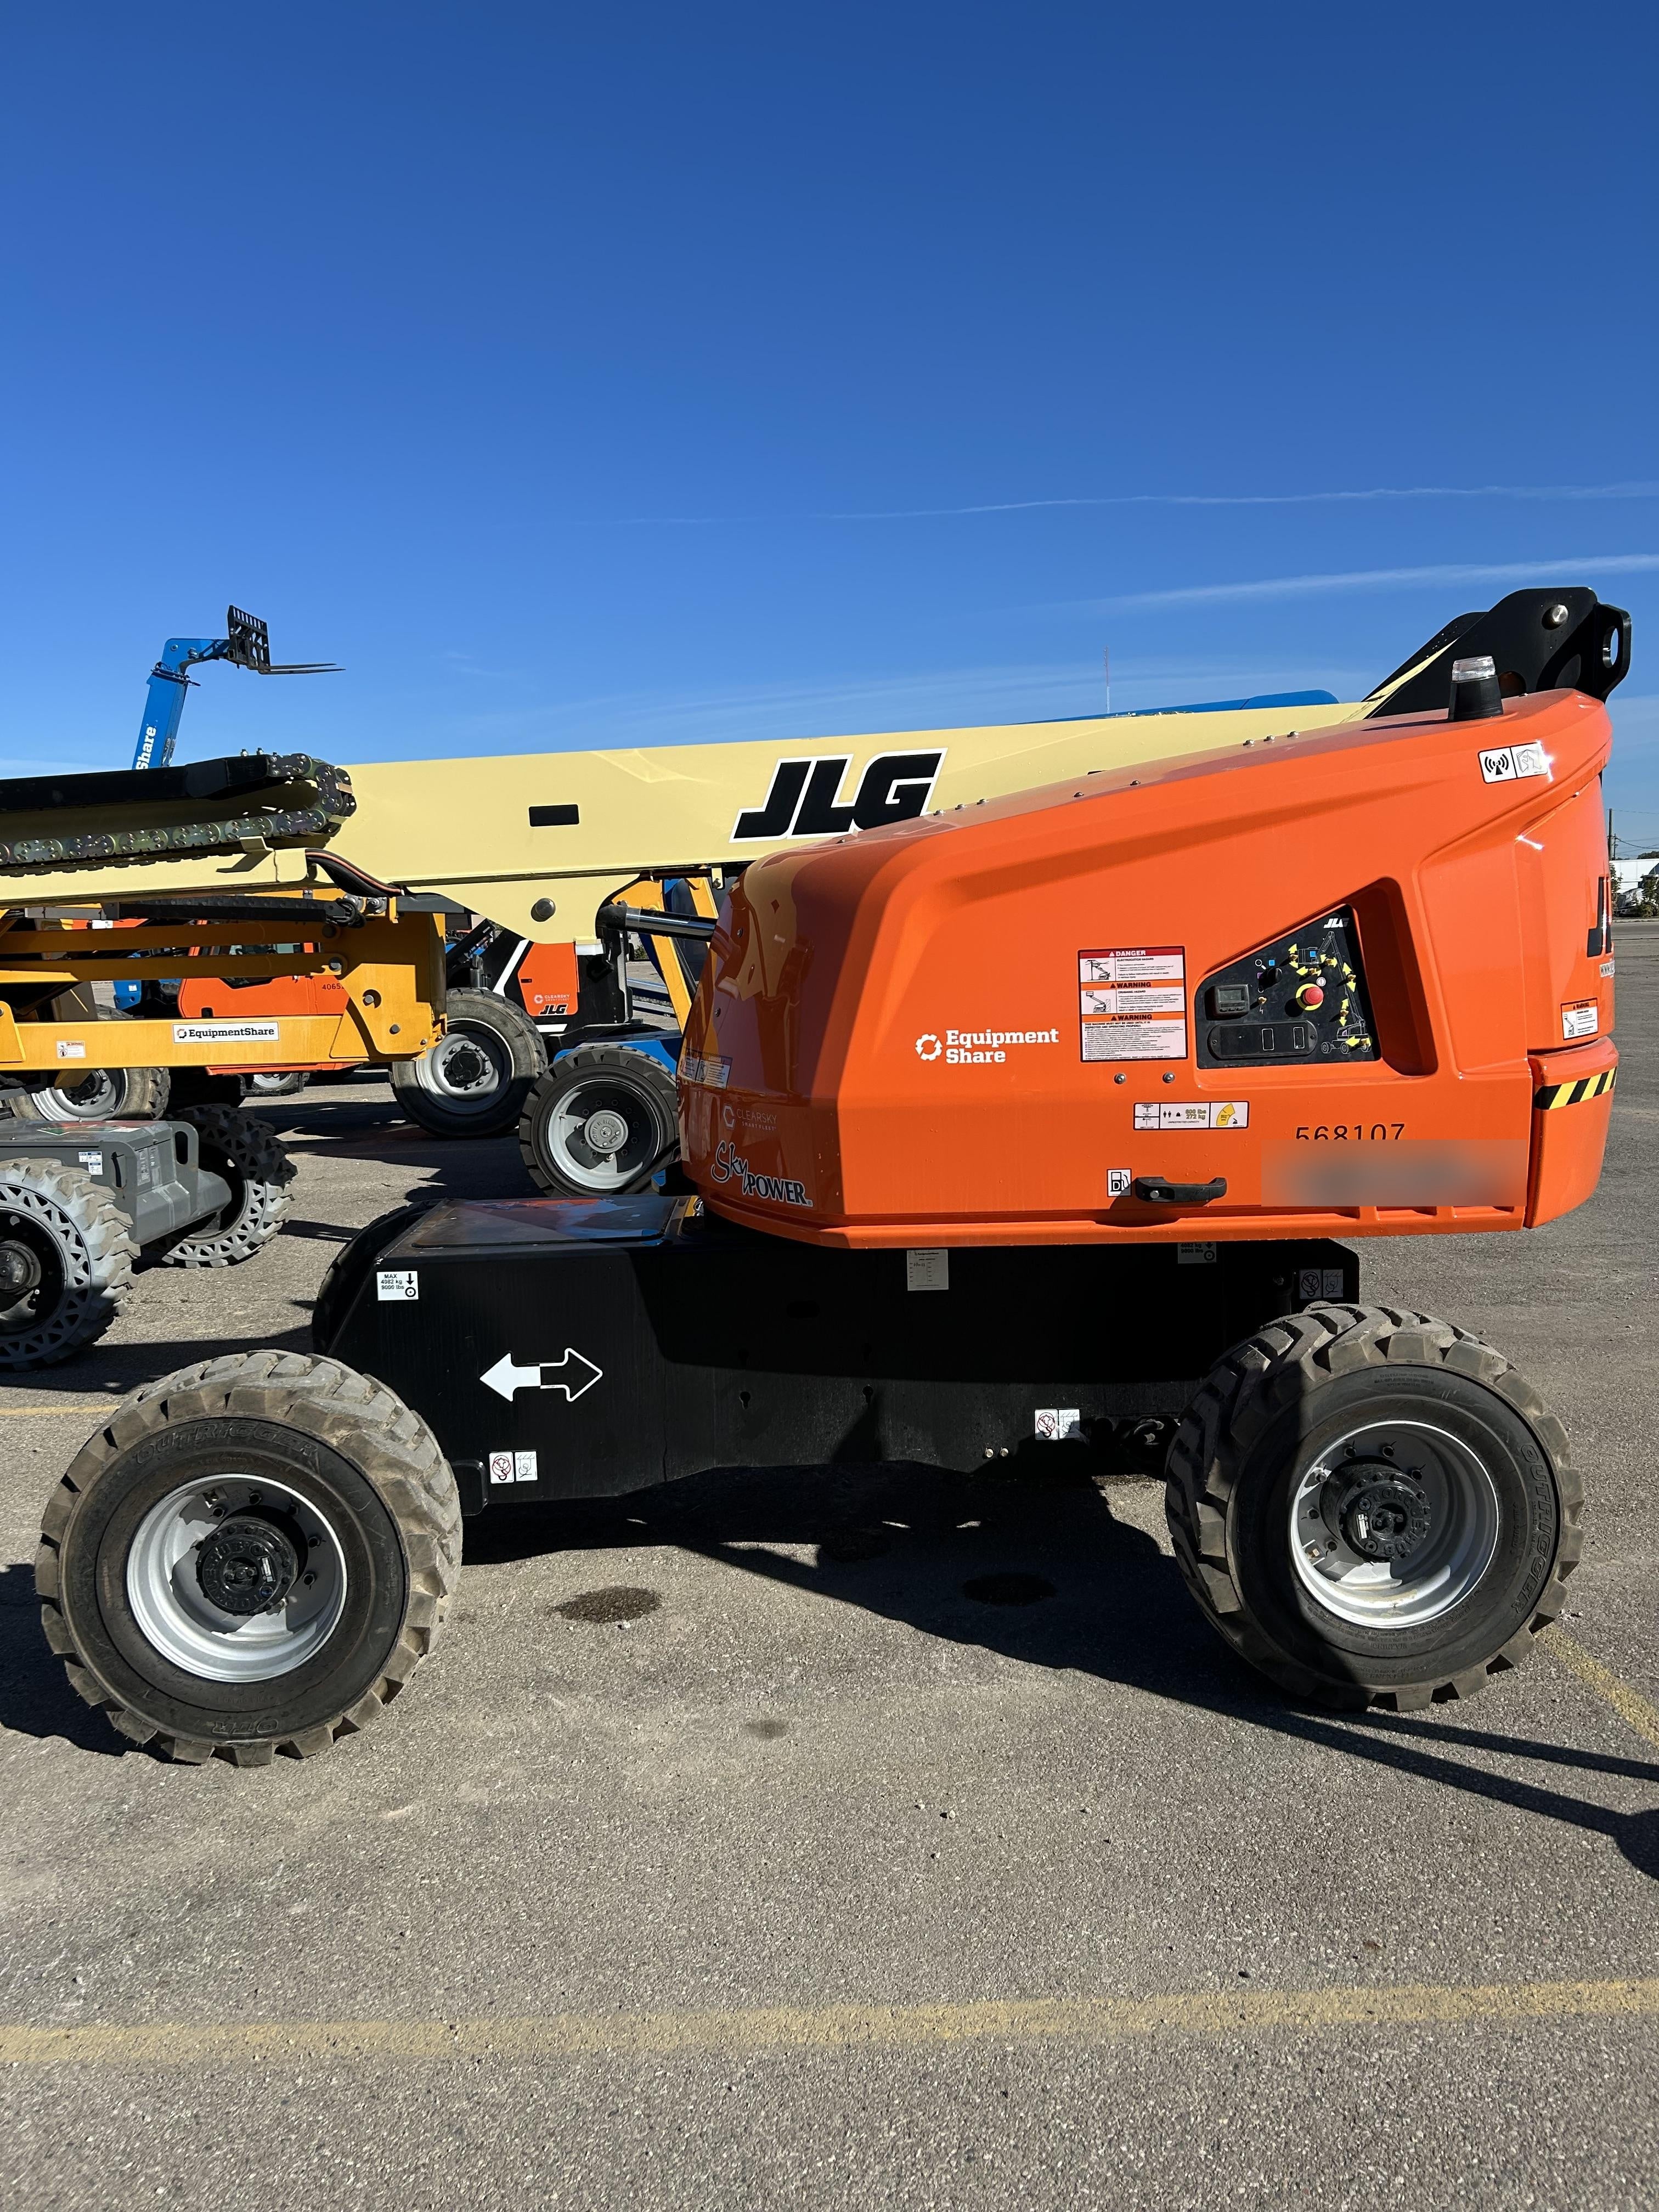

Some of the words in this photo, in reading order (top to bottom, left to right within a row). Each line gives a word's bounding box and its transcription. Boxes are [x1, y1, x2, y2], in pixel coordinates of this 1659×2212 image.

[135, 726, 156, 770] Share
[731, 750, 945, 840] JLG
[1323, 917, 1350, 928] JLG
[539, 1003, 567, 1015] JLG
[188, 1028, 274, 1039] EquipmentShare
[946, 1028, 1059, 1048] Equipment
[946, 1048, 1006, 1064] Share
[736, 1108, 777, 1124] CLEARSKY
[1295, 1123, 1406, 1140] 568107
[1511, 1443, 1553, 1614] OUTRIGGER
[211, 1718, 279, 1736] OTR
